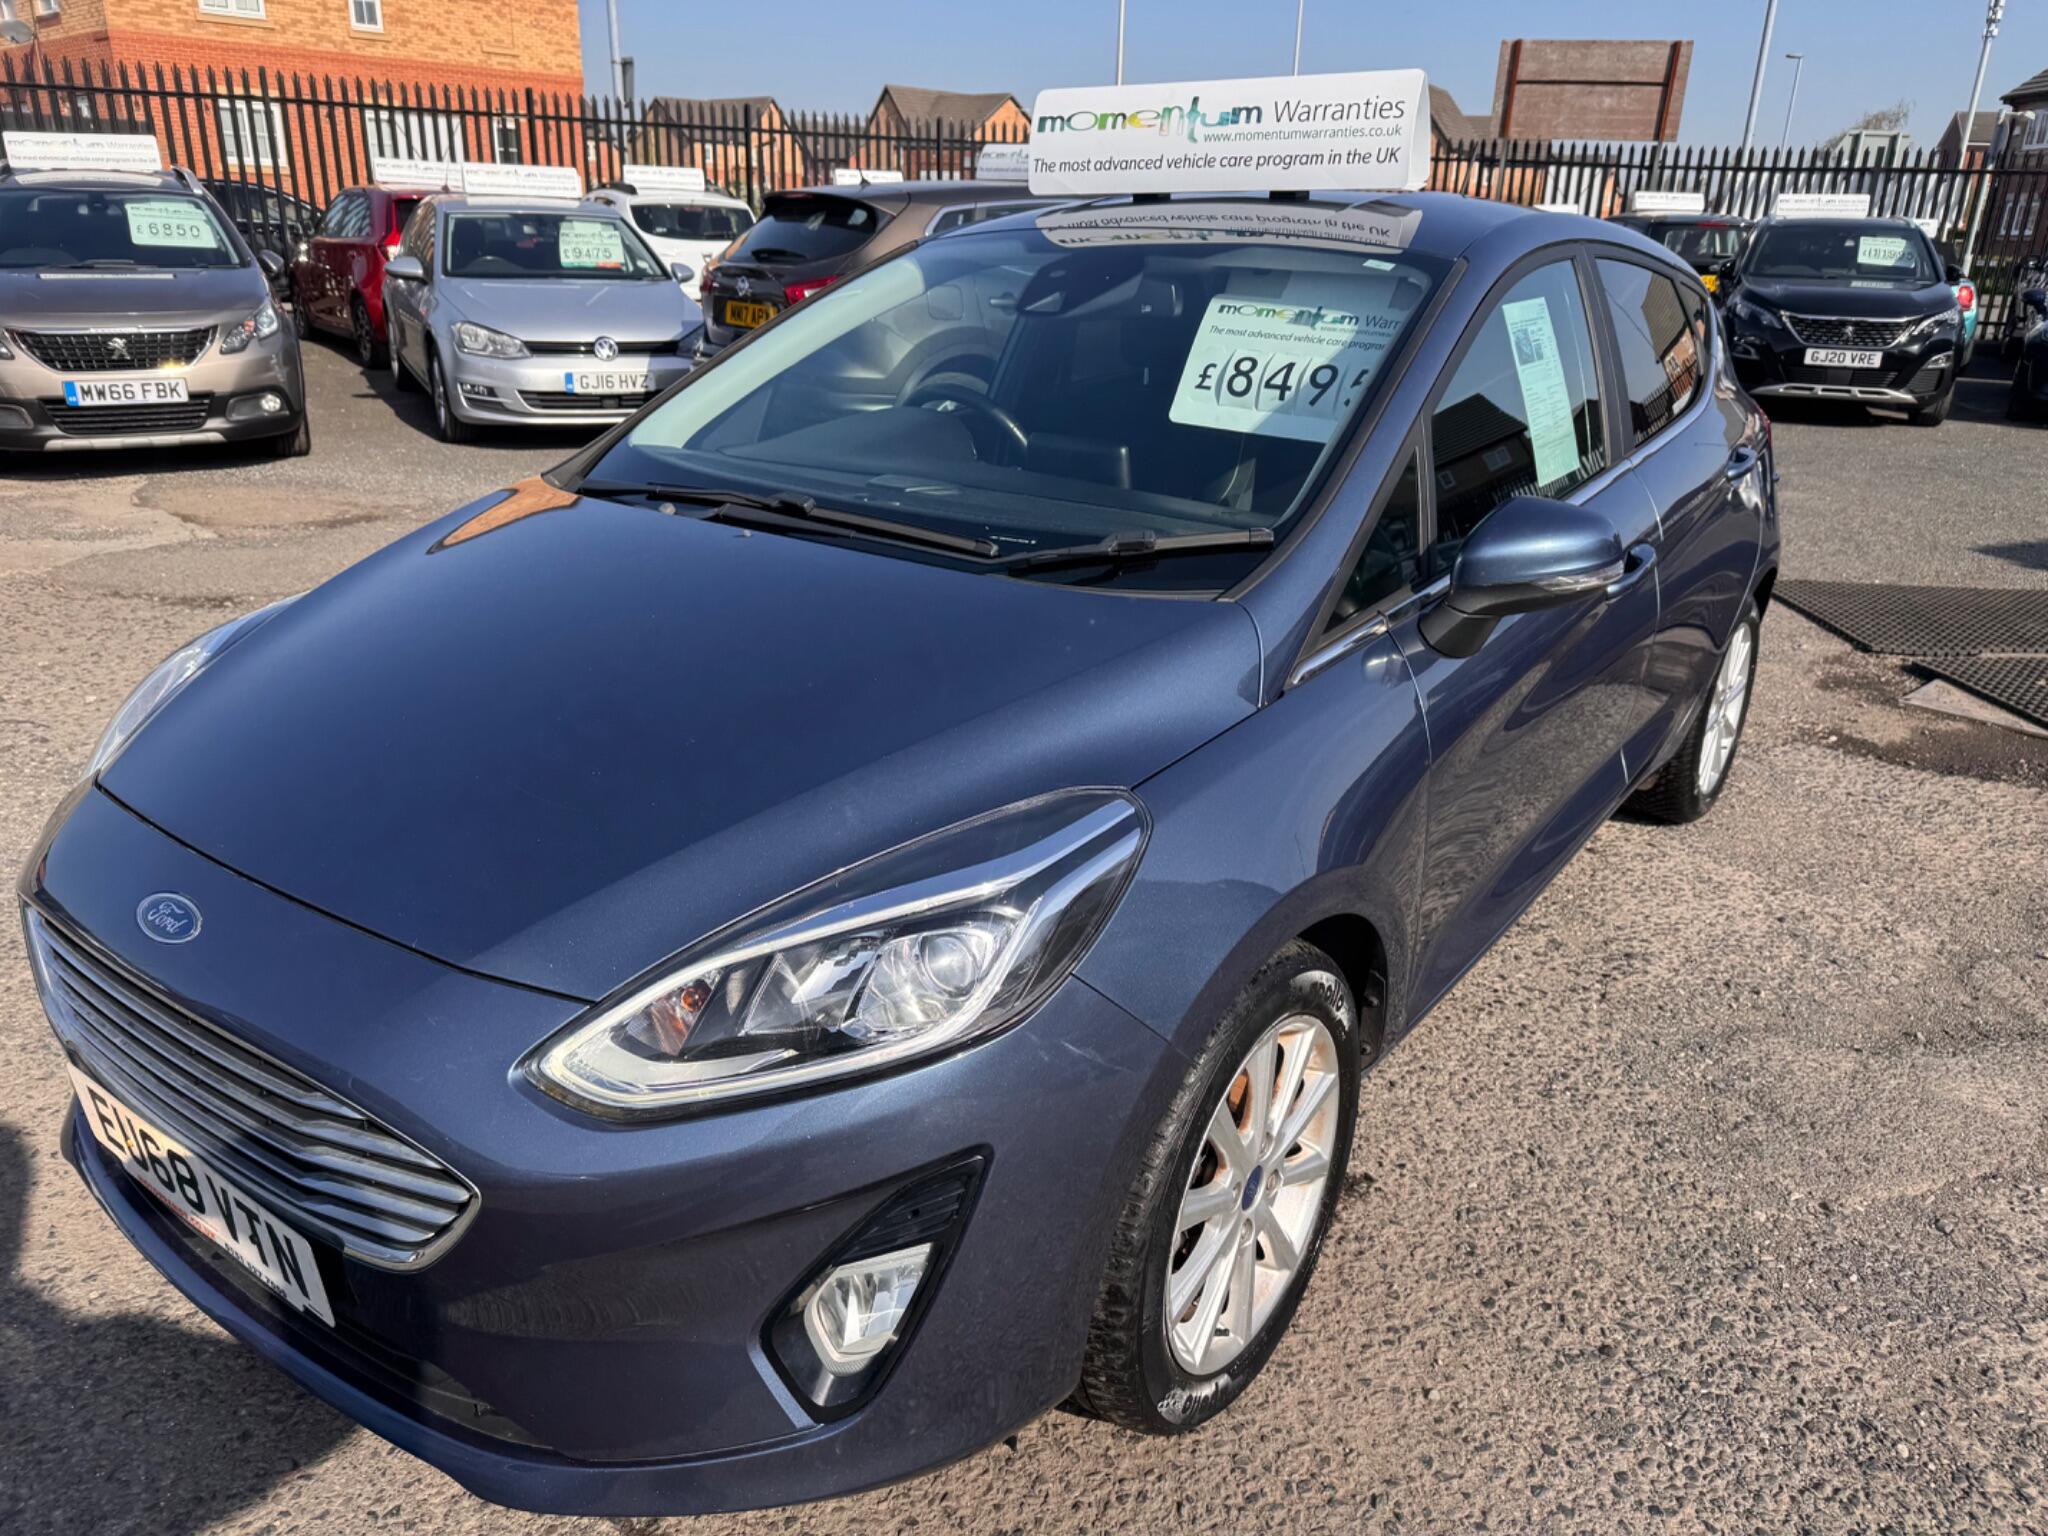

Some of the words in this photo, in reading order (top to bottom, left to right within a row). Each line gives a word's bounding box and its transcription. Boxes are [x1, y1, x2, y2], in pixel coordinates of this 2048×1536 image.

[1036, 96, 1263, 144] momentum
[1274, 95, 1405, 123] Warranties
[1203, 124, 1402, 143] www.momentumwarranties.co.uk
[1033, 157, 1056, 173] The
[1059, 156, 1091, 172] most
[1094, 154, 1163, 172] advanced
[1167, 153, 1216, 170] vehicle
[1219, 155, 1252, 168] care
[1256, 153, 1324, 171] program
[1328, 148, 1341, 165] in
[1346, 148, 1372, 165] the
[1376, 147, 1402, 165] UK
[1217, 304, 1359, 331] momentum
[1365, 313, 1402, 331] Warr
[1209, 325, 1225, 335] The
[1225, 327, 1247, 337] most
[1247, 329, 1293, 342] advanced
[1293, 333, 1325, 345] vehicle
[1326, 337, 1347, 346] care
[1348, 339, 1386, 352] progra
[1810, 350, 1847, 364] GJ20
[1850, 352, 1877, 365] VRE
[80, 383, 136, 402] MW66
[140, 381, 182, 399] FBK
[580, 374, 615, 390] GJ16
[619, 373, 649, 389] HVZ
[148, 901, 188, 934] Ford
[86, 1085, 206, 1215] EU68
[204, 1173, 311, 1301] VTN
